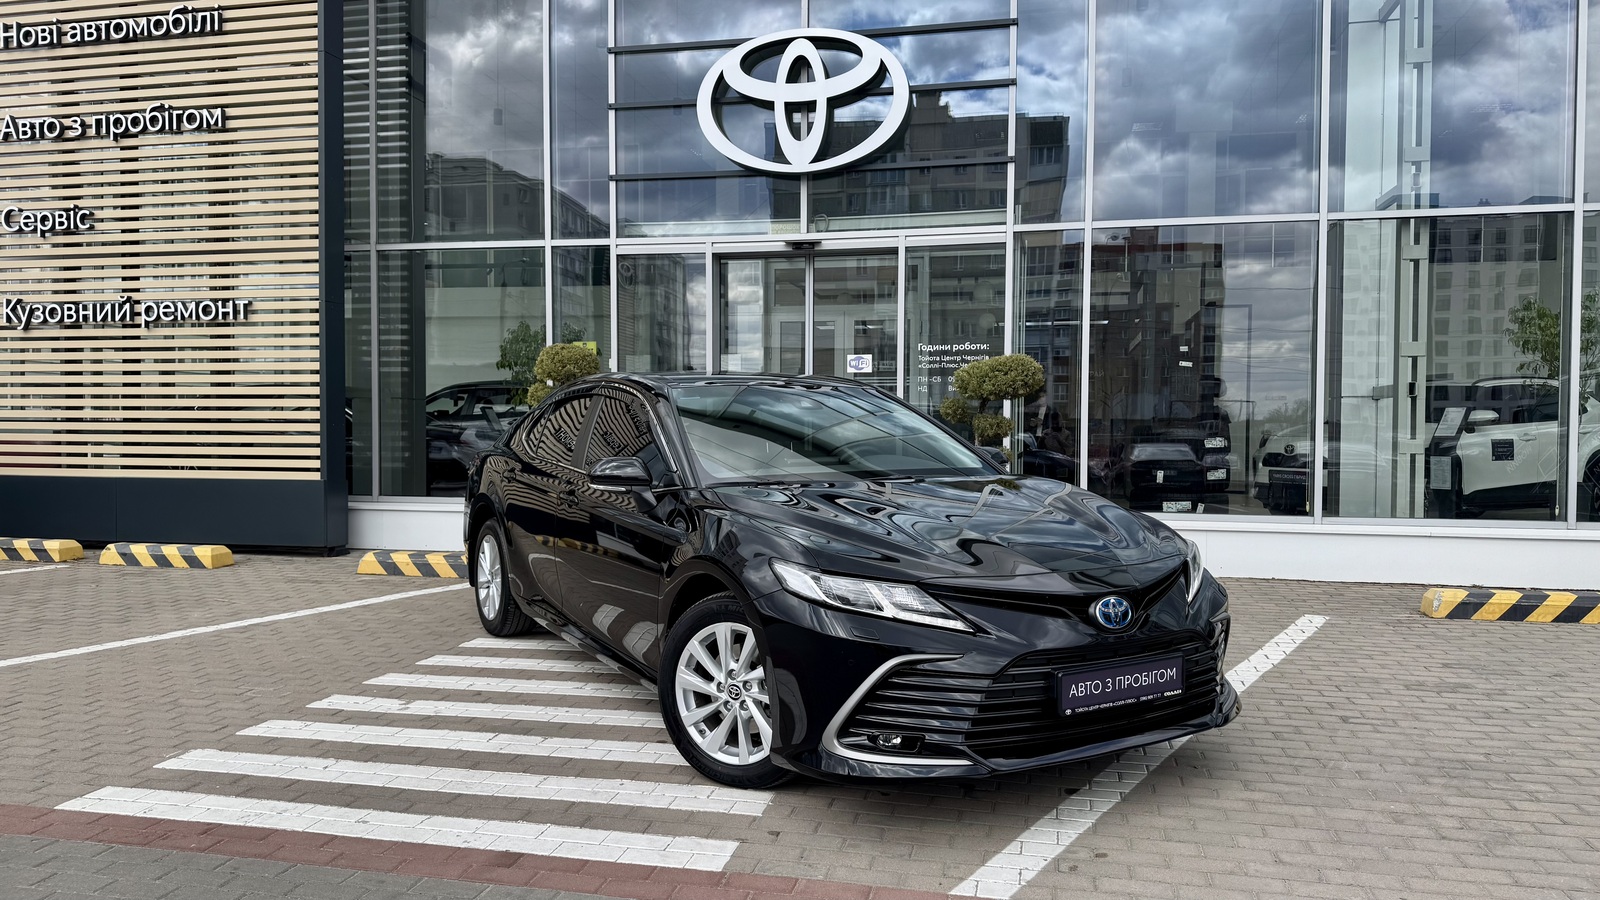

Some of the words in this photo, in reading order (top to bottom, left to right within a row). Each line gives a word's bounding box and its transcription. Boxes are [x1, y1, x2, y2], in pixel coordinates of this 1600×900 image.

[0, 18, 58, 48] Нові
[66, 4, 223, 43] автомобілі
[1, 114, 60, 140] Авто
[69, 117, 83, 136] з
[92, 103, 225, 141] пробігом
[1, 204, 92, 237] Сервіс
[2, 296, 133, 330] Кузовний
[142, 299, 250, 328] ремонт
[917, 343, 951, 352] Години
[952, 342, 990, 352] роботи:
[1069, 680, 1103, 698] АВТО
[1105, 678, 1113, 692] З
[1115, 667, 1177, 690] ПРОБІГОМ
